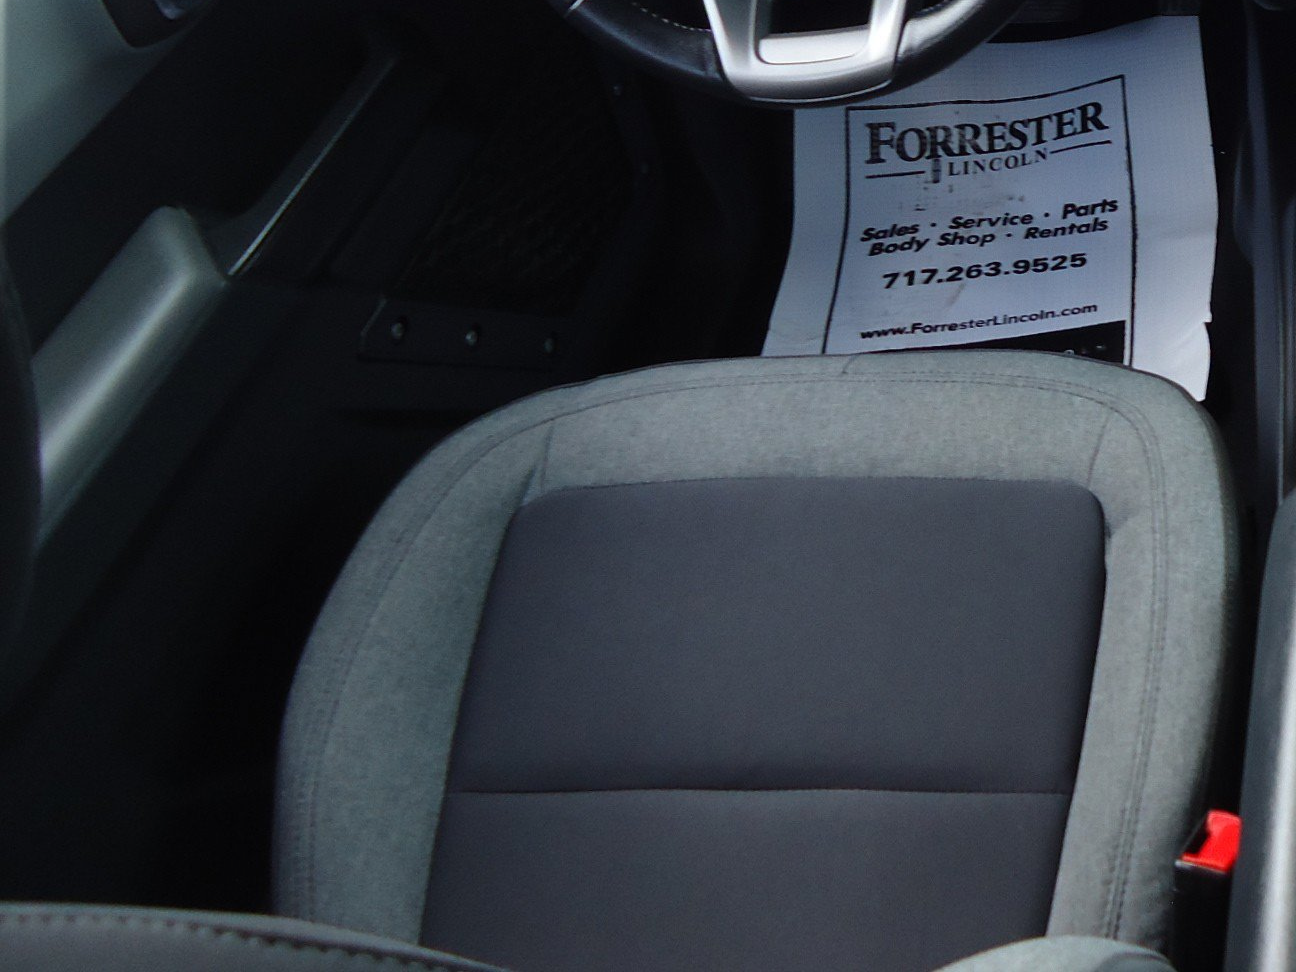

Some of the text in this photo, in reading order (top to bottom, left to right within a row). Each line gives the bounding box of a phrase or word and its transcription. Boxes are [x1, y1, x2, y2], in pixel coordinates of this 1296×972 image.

[865, 101, 1109, 164] FORRESTER
[948, 147, 1049, 177] LINCOLN
[860, 197, 1119, 242] Sales Service Parts
[868, 217, 1109, 257] Body Shop Rentals
[882, 253, 1088, 290] 717.263.9525
[859, 303, 1098, 340] www.ForresterLincoln.com
